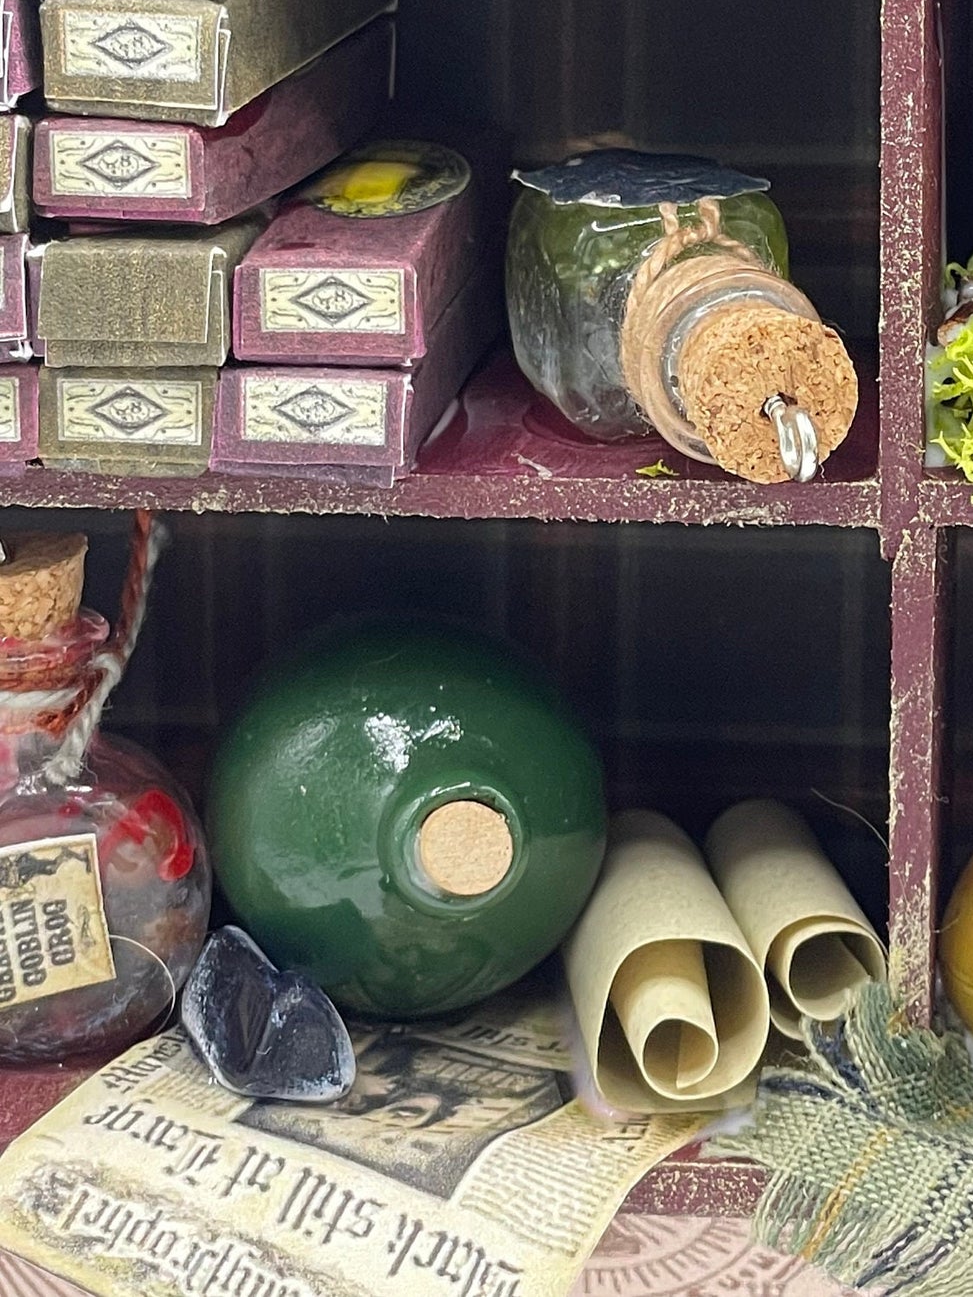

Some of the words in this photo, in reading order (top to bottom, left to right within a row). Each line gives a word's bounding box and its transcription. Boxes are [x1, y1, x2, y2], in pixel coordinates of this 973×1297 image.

[11, 899, 47, 987] GOBLIN
[222, 1146, 286, 1197] at
[278, 1167, 387, 1244] still
